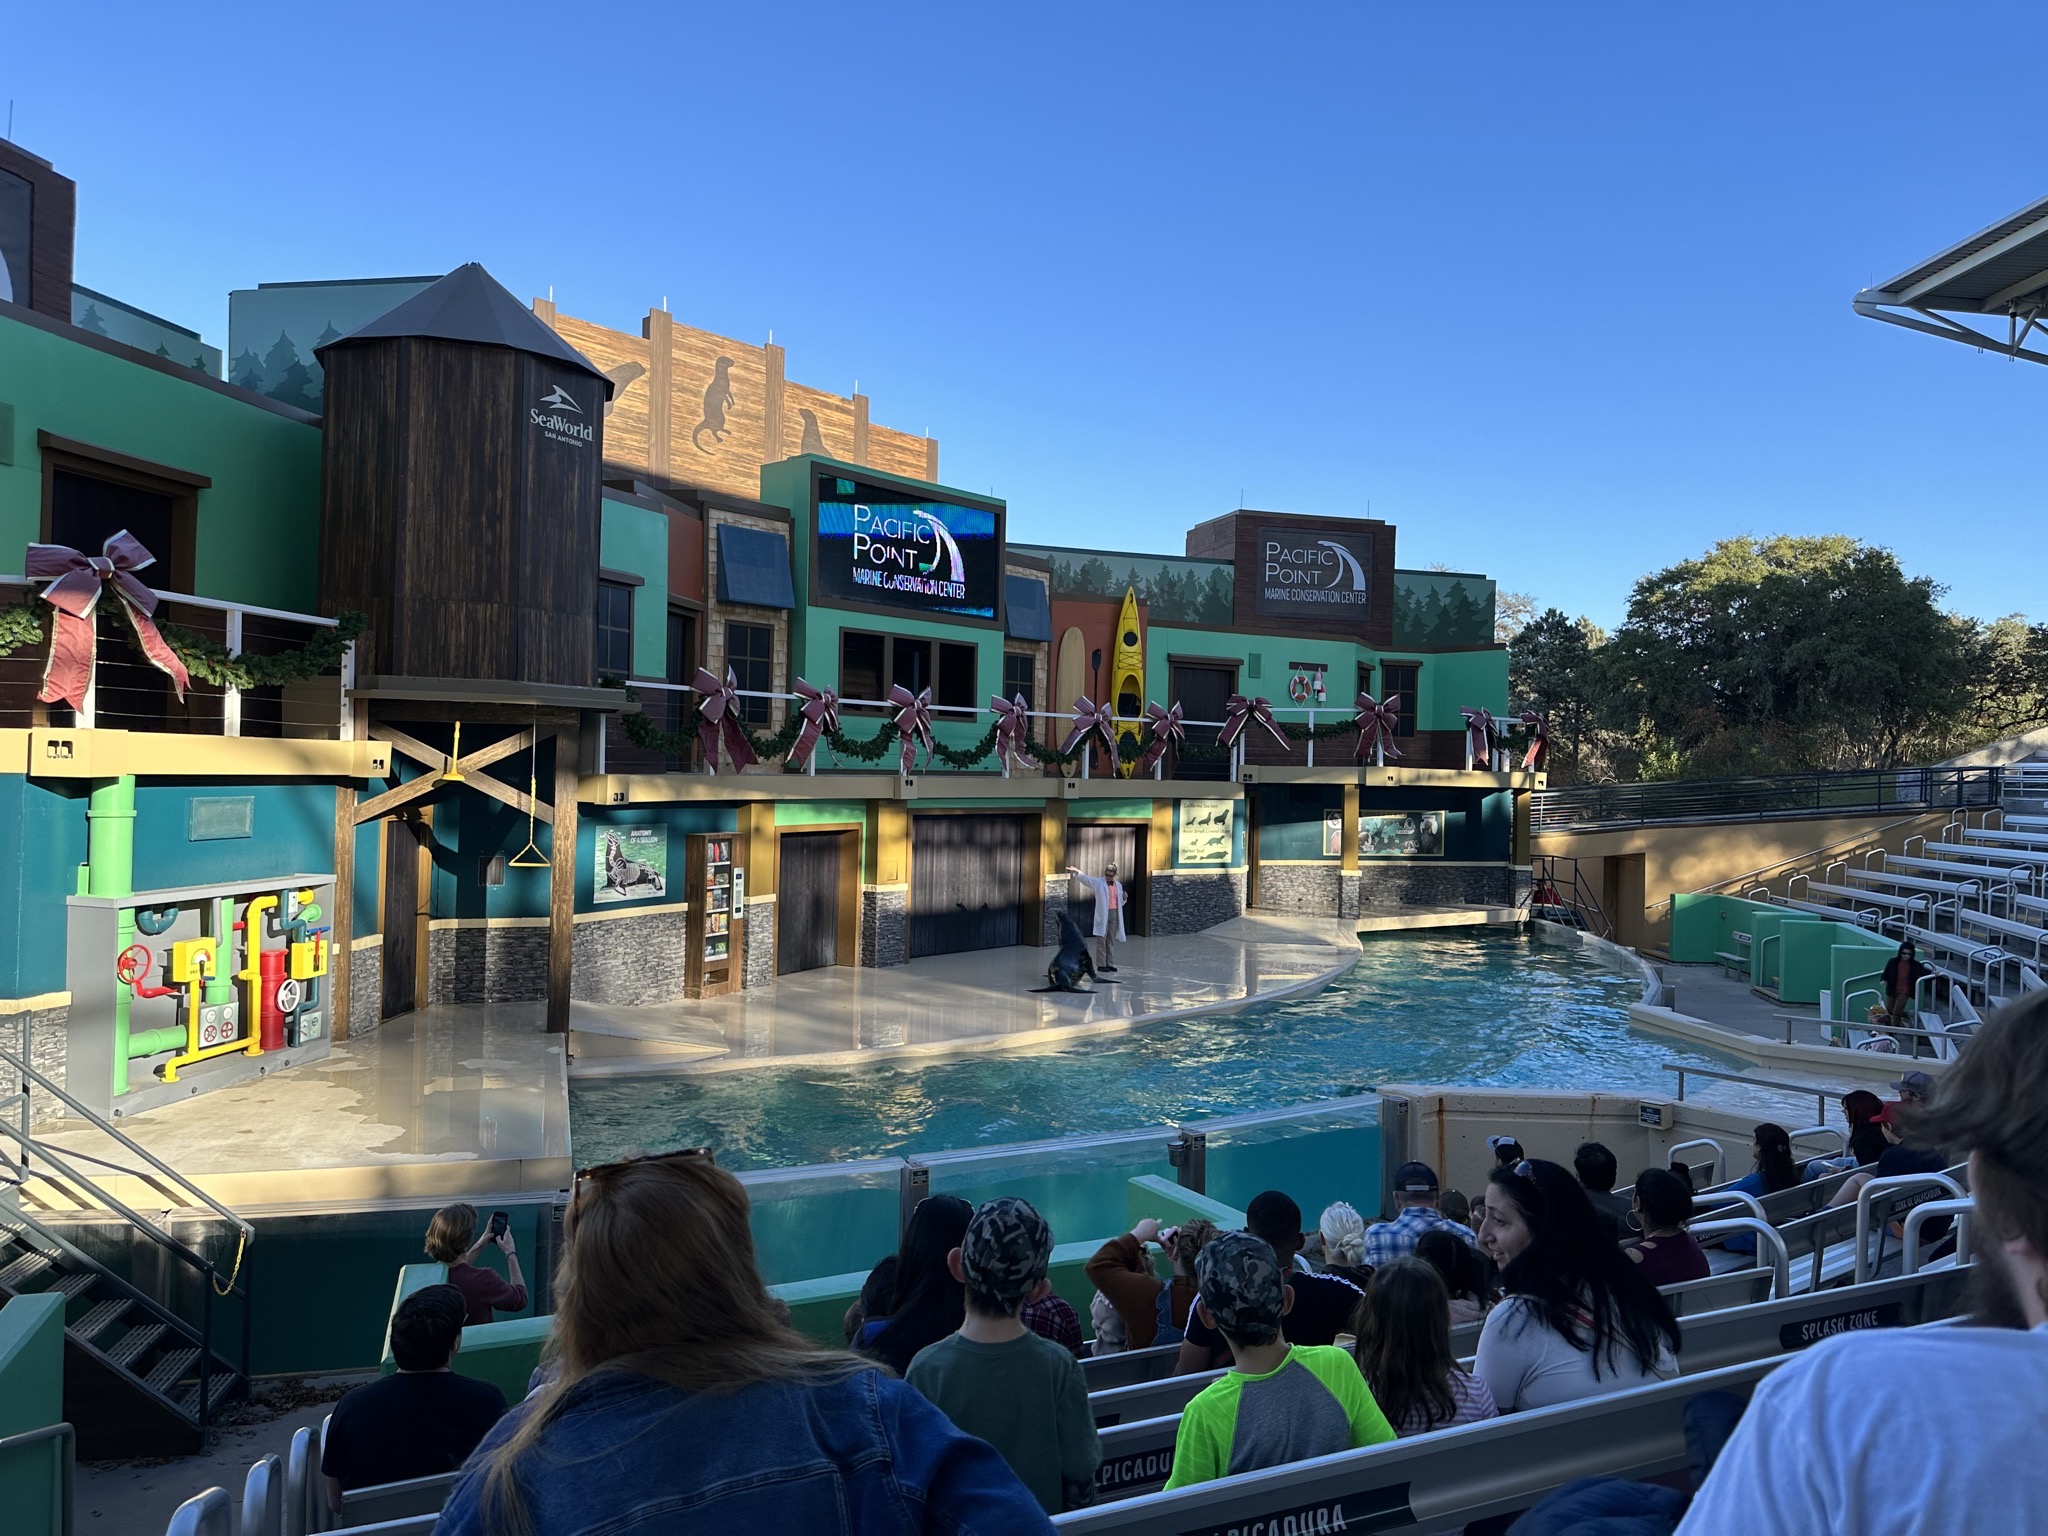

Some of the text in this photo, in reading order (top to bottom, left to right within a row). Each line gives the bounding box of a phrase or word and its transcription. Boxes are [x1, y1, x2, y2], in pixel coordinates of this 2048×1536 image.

[530, 408, 593, 441] SeaWorld
[544, 430, 583, 448] SAN ANTONIO
[853, 504, 930, 544] PACIFIC
[853, 533, 918, 570] POINT
[1266, 541, 1334, 566] PACIFIC
[852, 566, 883, 587] MARINE
[938, 580, 966, 600] CENTER
[1265, 562, 1322, 585] POINT
[1264, 587, 1367, 604] MARINE CONSERVATION CENTER
[1802, 1310, 1878, 1341] SPLASH ZONE
